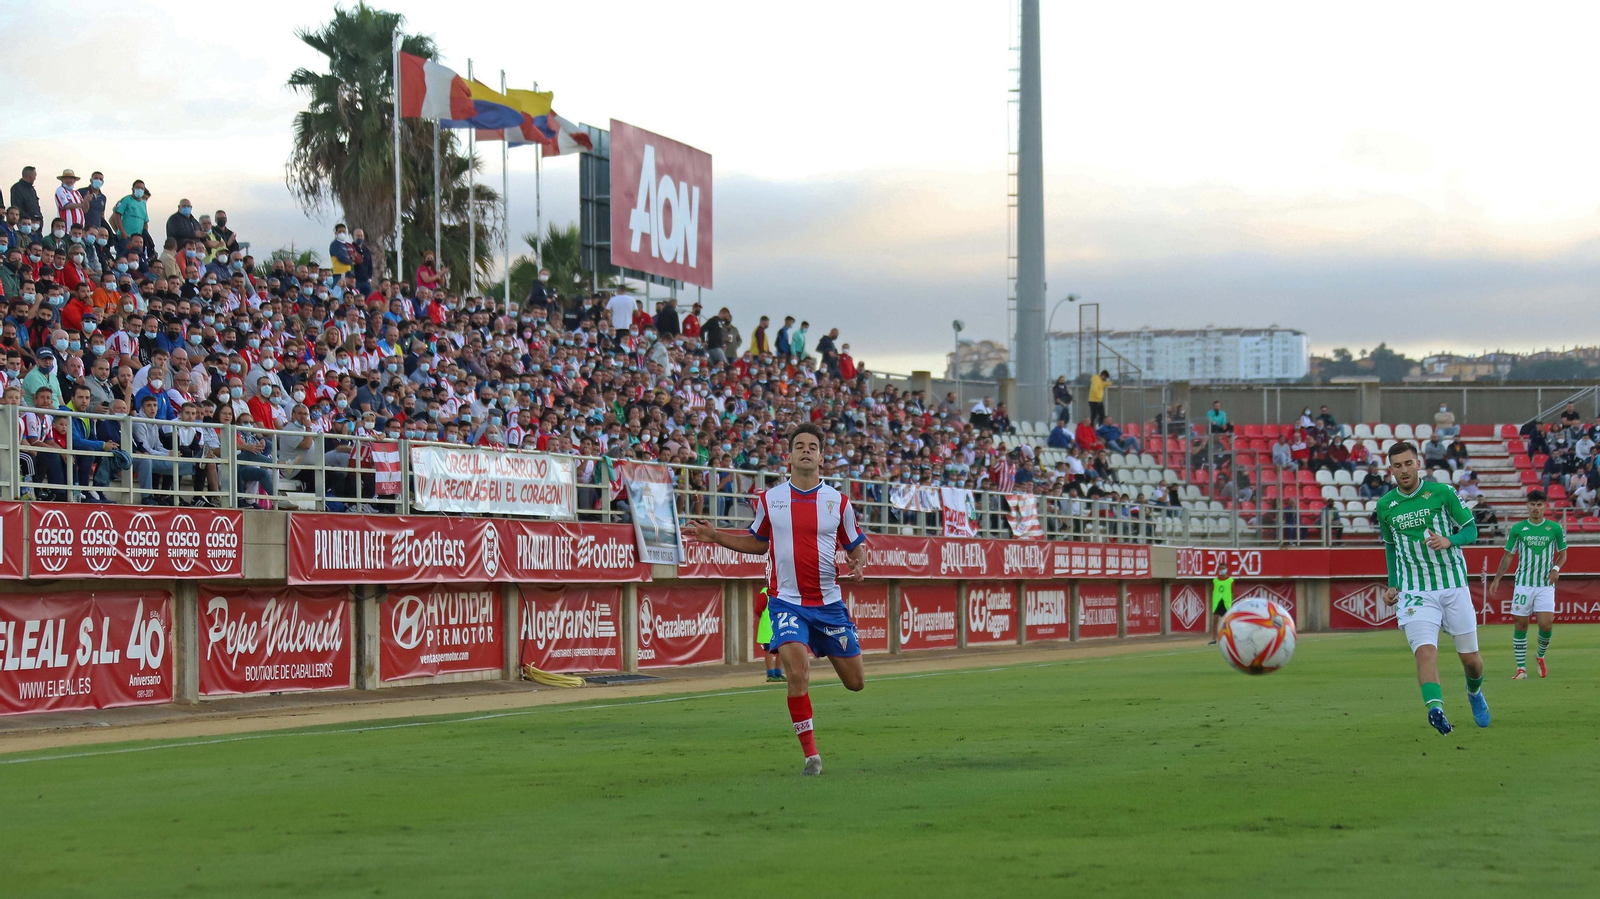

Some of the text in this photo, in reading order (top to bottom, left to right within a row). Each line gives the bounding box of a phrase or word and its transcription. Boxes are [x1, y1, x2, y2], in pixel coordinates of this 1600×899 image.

[629, 144, 700, 269] AON
[490, 480, 502, 502] EN
[506, 481, 517, 503] EL
[1392, 508, 1430, 524] FOREVER
[1399, 518, 1426, 530] GREEN
[35, 528, 74, 545] COSCO
[80, 529, 118, 546] COSCO
[124, 530, 160, 546] COSCO
[166, 532, 200, 547] COSCO
[206, 533, 238, 548] COSCO
[36, 546, 72, 556] SHIPPING
[82, 547, 117, 557] SHIPPING
[126, 548, 159, 558] SHIPPING
[168, 548, 199, 558] SHIPPING
[207, 549, 236, 559] SHIPPING
[314, 530, 362, 569] PRIMERA
[404, 530, 465, 567] Footters
[517, 534, 553, 570] PRIMERA
[587, 535, 635, 569] Footters
[1404, 593, 1424, 608] 22
[1514, 593, 1527, 606] 20
[427, 591, 493, 626] HYUNDAI
[520, 601, 600, 650] Algetransit
[655, 612, 719, 639] Grazalema Motor
[914, 606, 954, 638] Expressreformas
[986, 611, 1010, 639] Gaggero
[76, 616, 120, 666] S.L.
[126, 597, 165, 670] 40
[206, 596, 343, 671] Pepe Valencia
[426, 626, 494, 647] PERMOTOR
[420, 651, 469, 665] ventaspermotor.com
[637, 648, 655, 660] ŠKODA
[128, 672, 161, 686] Aniversario
[245, 663, 333, 681] BOUTIQUE DE CABALLEROS
[19, 677, 91, 699] WWW.ELEAL.ES
